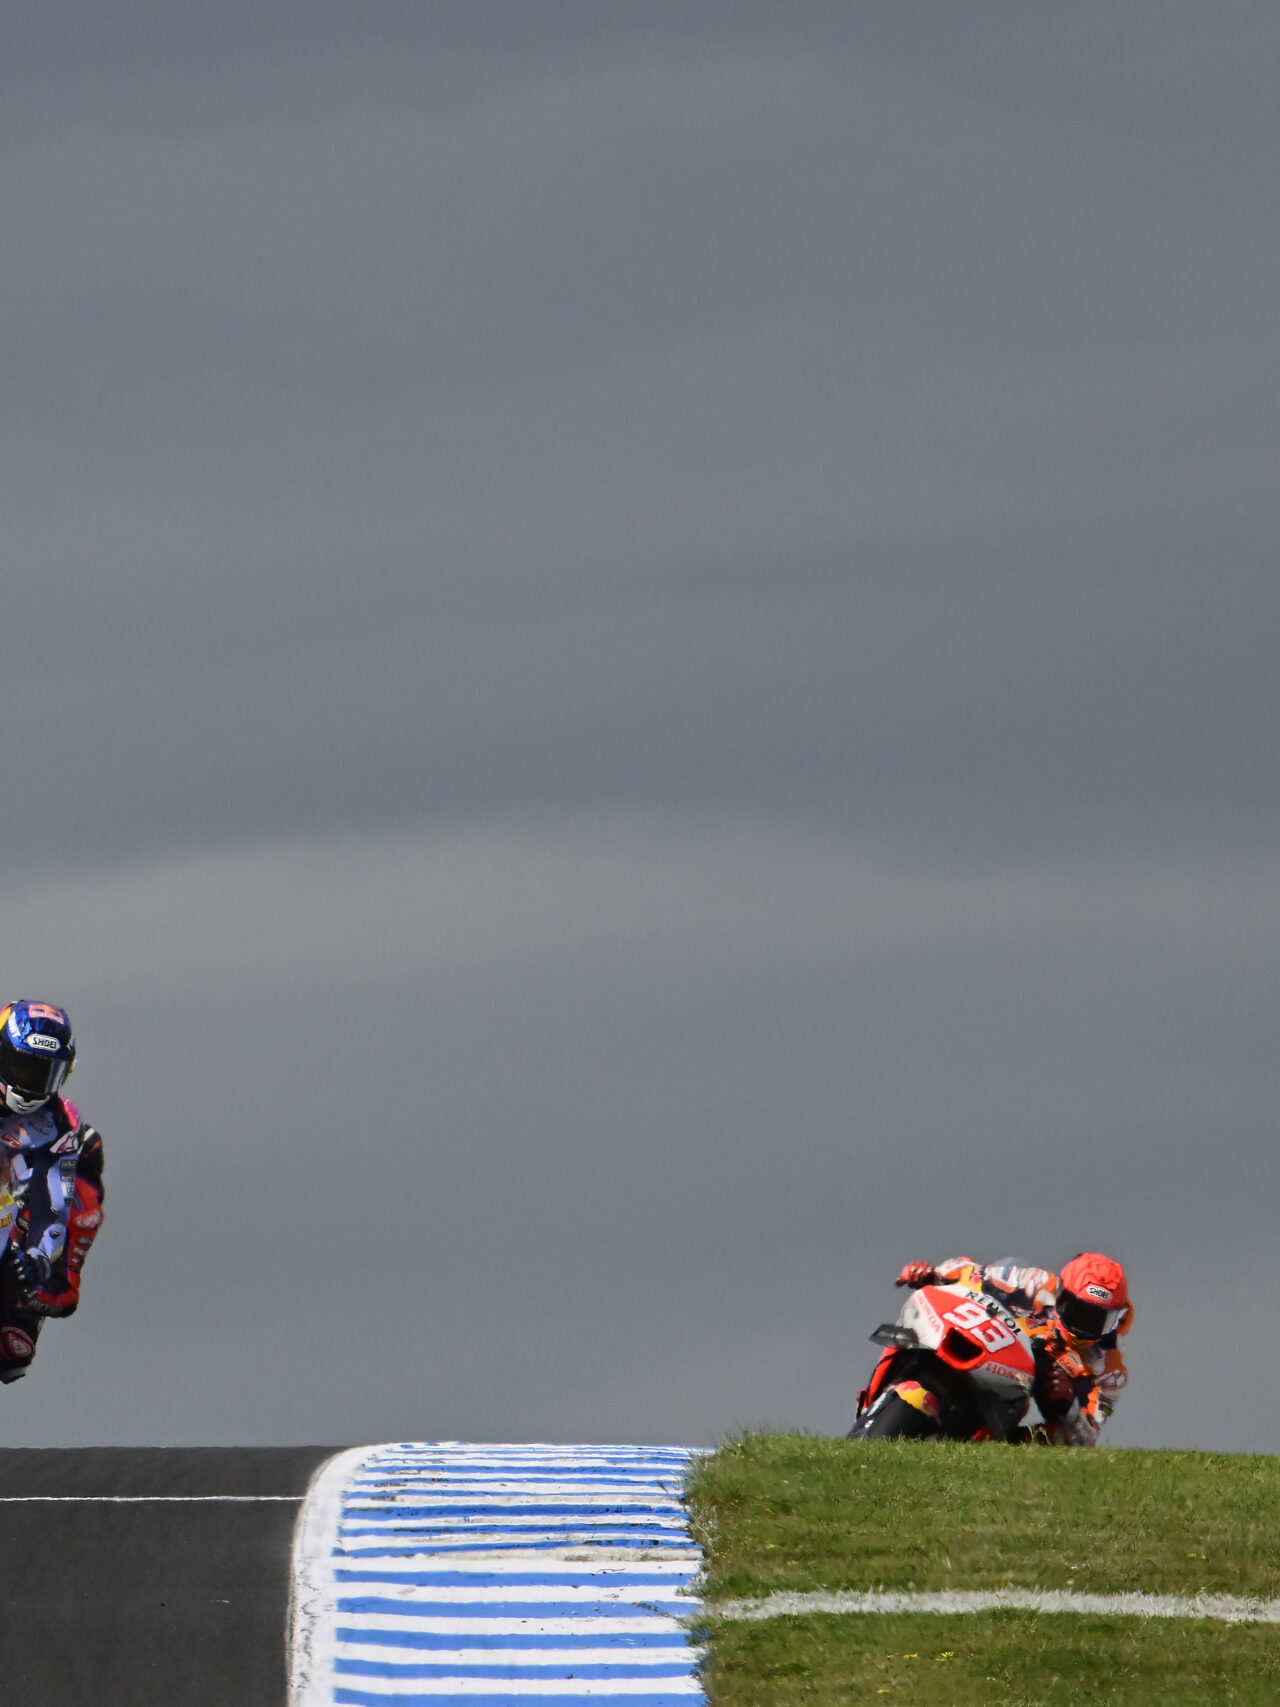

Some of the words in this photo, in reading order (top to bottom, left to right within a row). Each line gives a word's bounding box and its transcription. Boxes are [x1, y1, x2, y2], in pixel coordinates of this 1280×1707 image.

[32, 1036, 58, 1050] SHOEI
[1088, 1286, 1110, 1300] SHOEI
[942, 1302, 1017, 1353] 93
